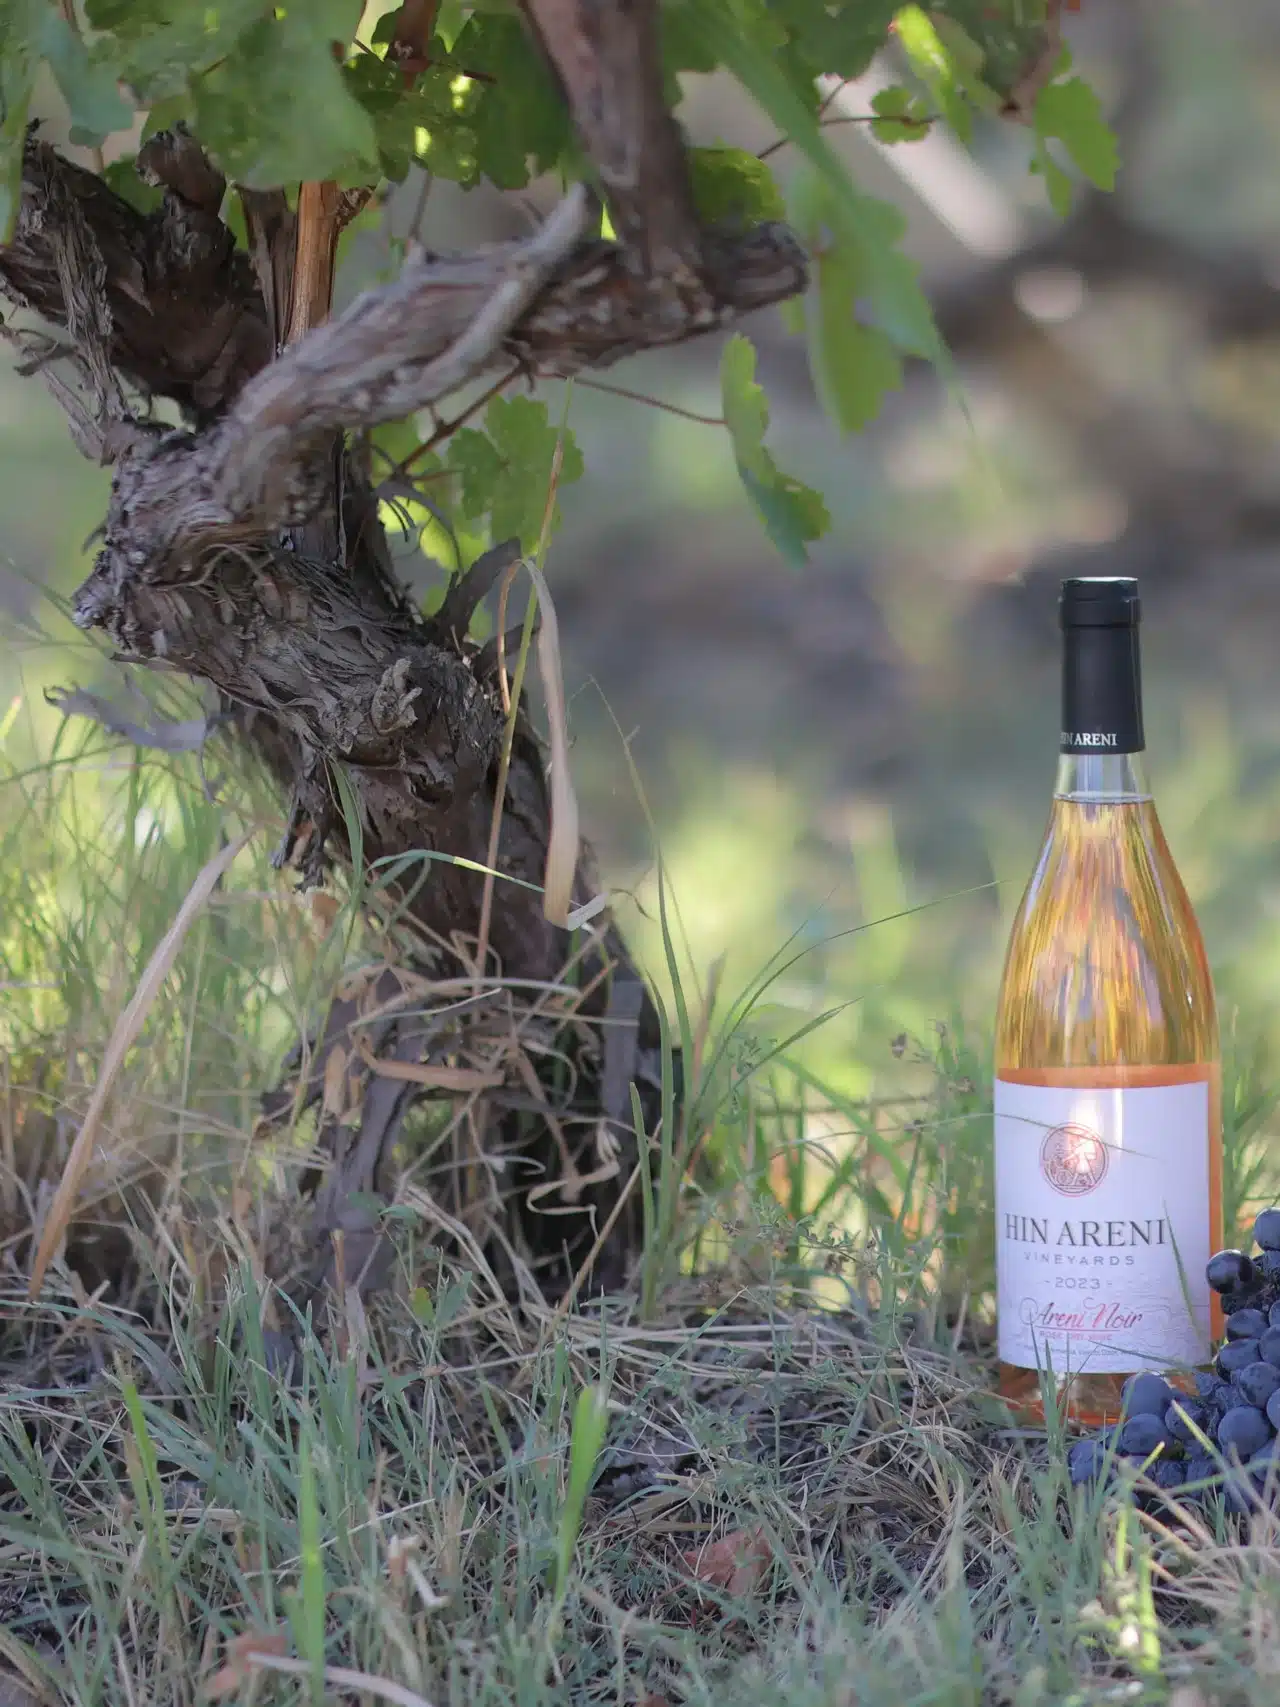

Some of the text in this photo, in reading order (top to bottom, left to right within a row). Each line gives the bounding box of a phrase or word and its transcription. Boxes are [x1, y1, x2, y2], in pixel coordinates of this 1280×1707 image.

[1074, 732, 1118, 746] ARENI
[1004, 1212, 1168, 1247] HIN ARENI
[1024, 1252, 1135, 1266] VINEYARDS
[1055, 1276, 1101, 1290] 2023
[1019, 1297, 1143, 1329] Areni Noir
